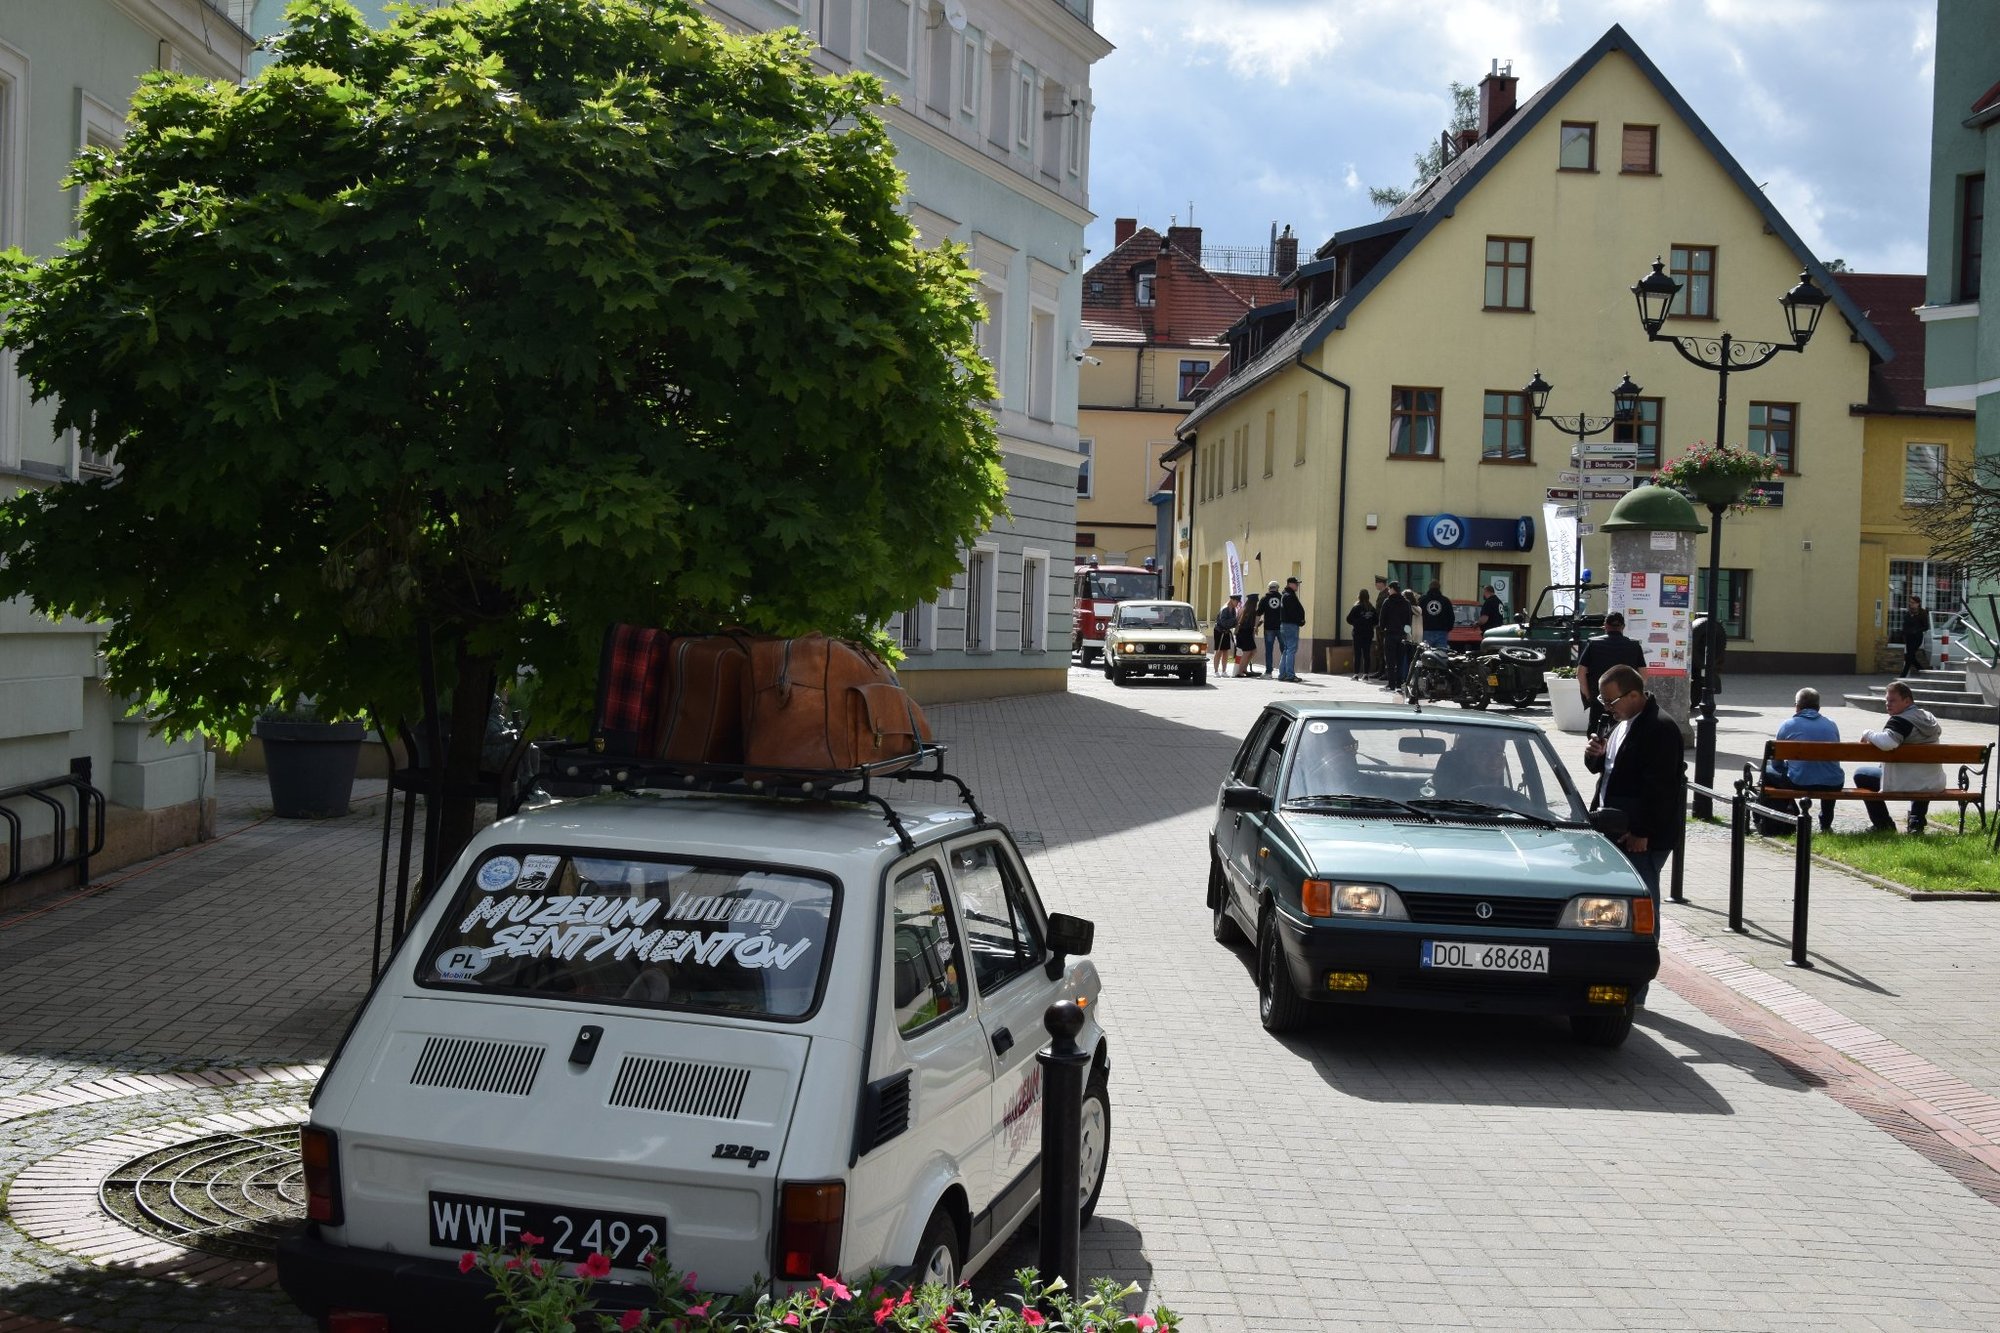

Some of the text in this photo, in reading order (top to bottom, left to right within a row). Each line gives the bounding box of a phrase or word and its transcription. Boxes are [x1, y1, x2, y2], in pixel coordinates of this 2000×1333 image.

[1436, 524, 1457, 540] PZU
[1485, 540, 1504, 548] Agent
[459, 889, 793, 933] MUZEUM kowary
[480, 925, 813, 970] SENTYMENTÓW
[1423, 956, 1431, 964] PL
[1434, 944, 1545, 970] DOL 6868A
[449, 953, 476, 969] PL
[711, 1143, 770, 1169] 126p
[552, 1215, 658, 1264] 2492
